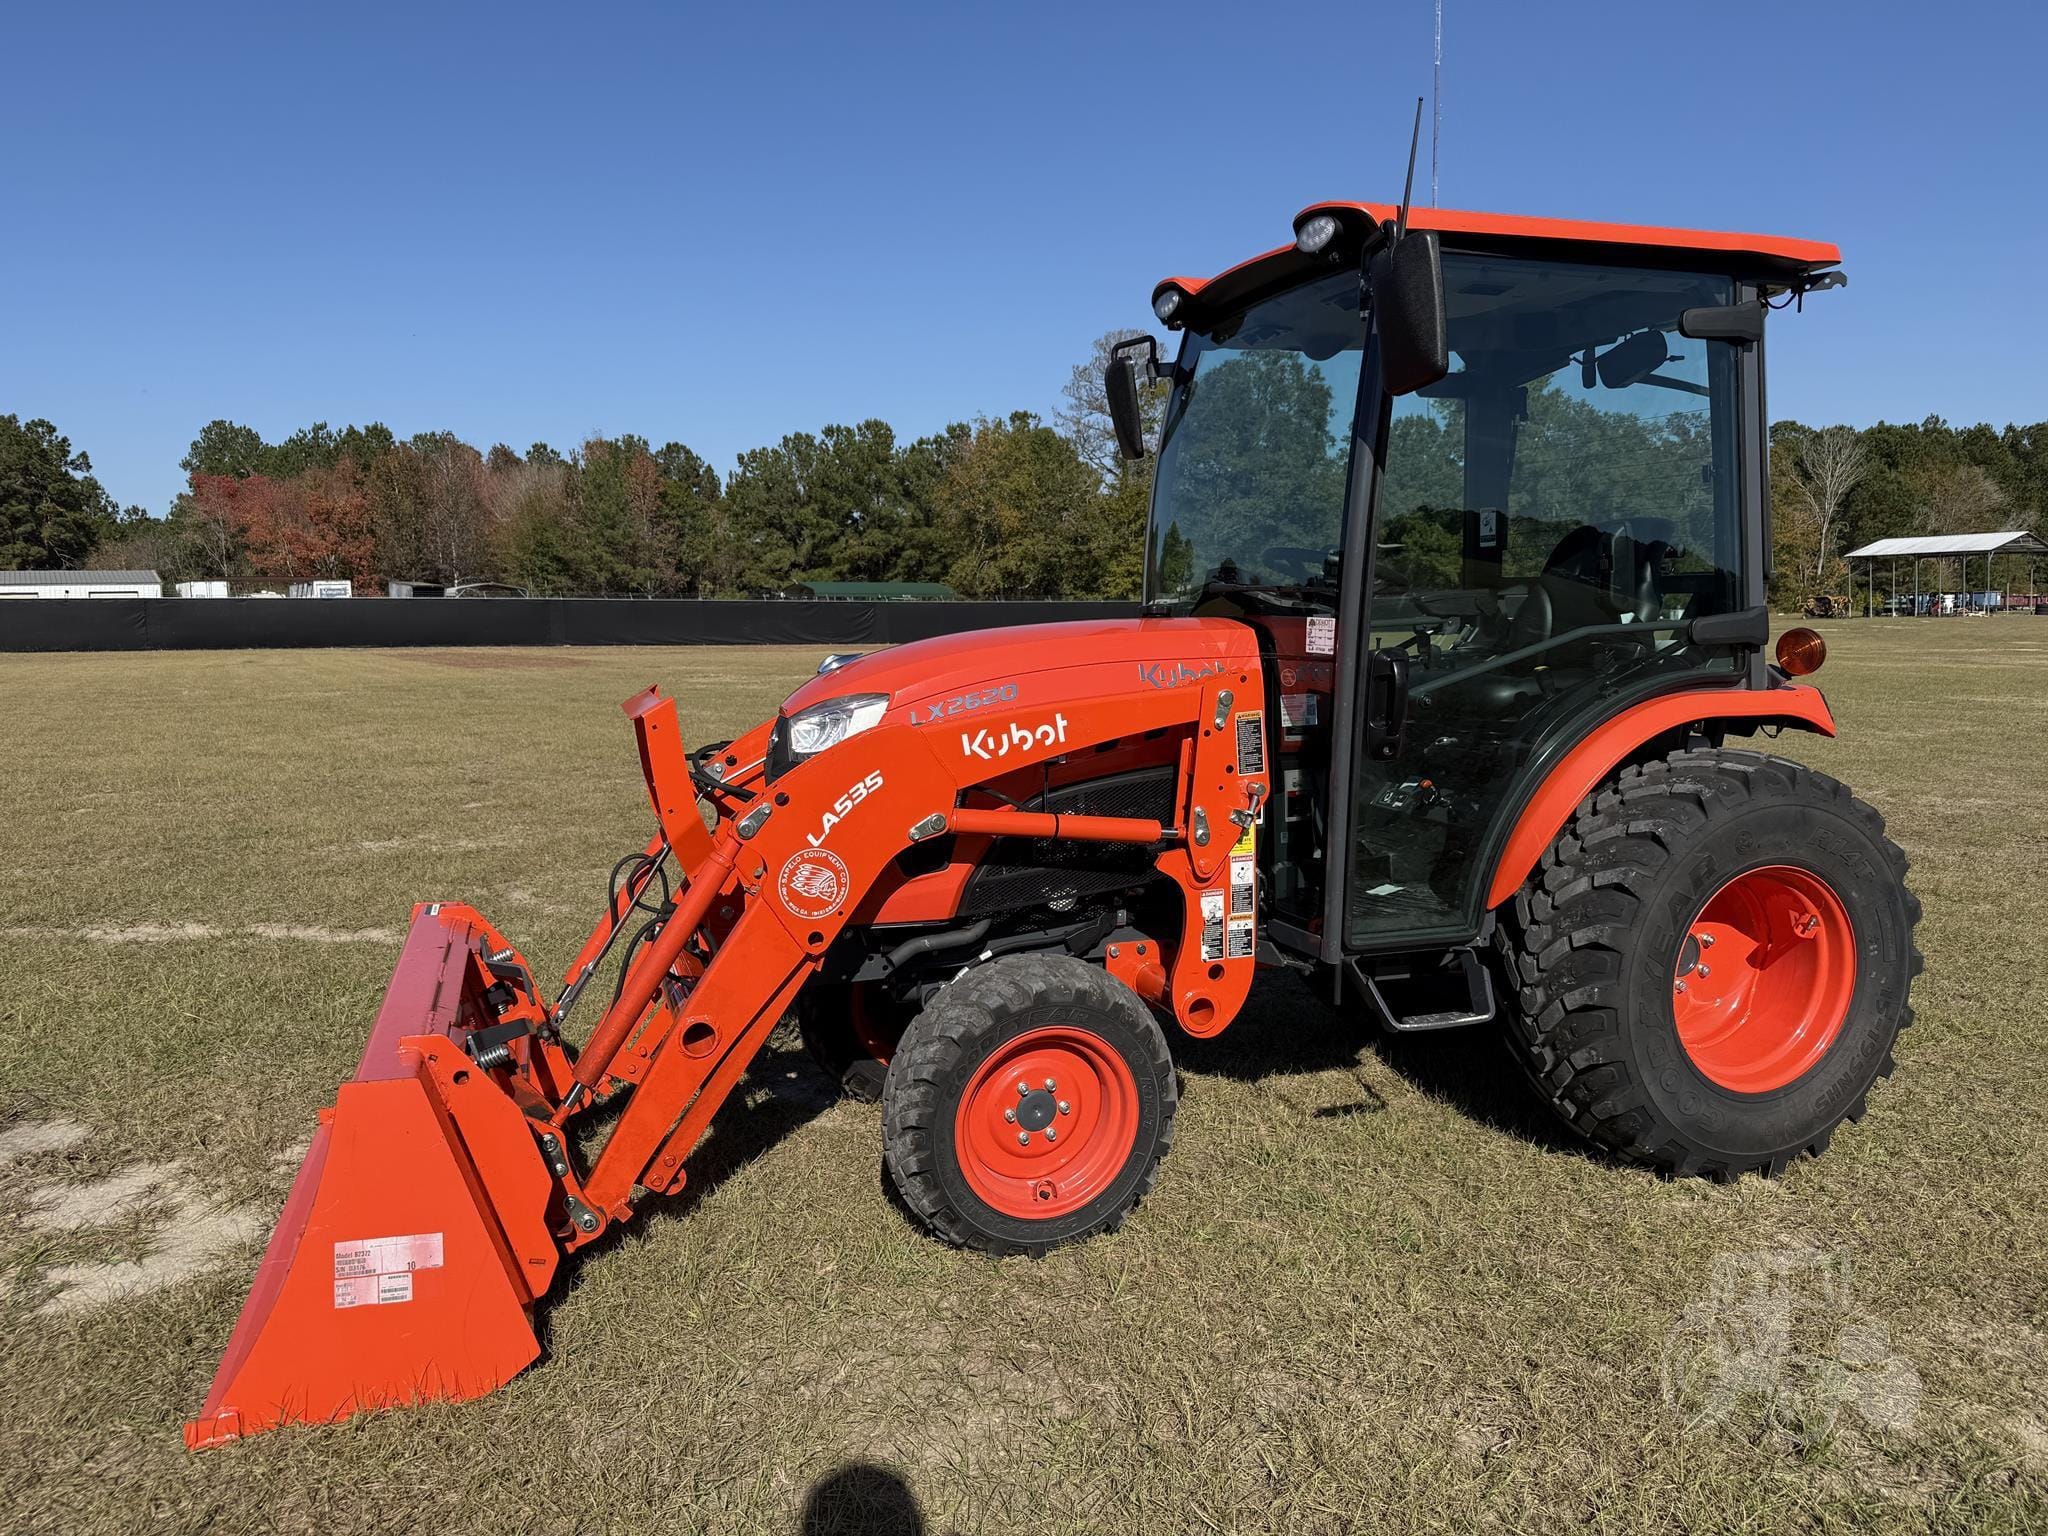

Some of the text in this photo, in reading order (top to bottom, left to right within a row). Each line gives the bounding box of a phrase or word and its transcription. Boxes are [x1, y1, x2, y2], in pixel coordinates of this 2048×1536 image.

[910, 683, 1018, 726] LX2620
[806, 769, 884, 847] LA535
[781, 856, 801, 884] SAPELO
[1806, 825, 1878, 880] R14T
[1638, 854, 1727, 1135] GOODYEAR
